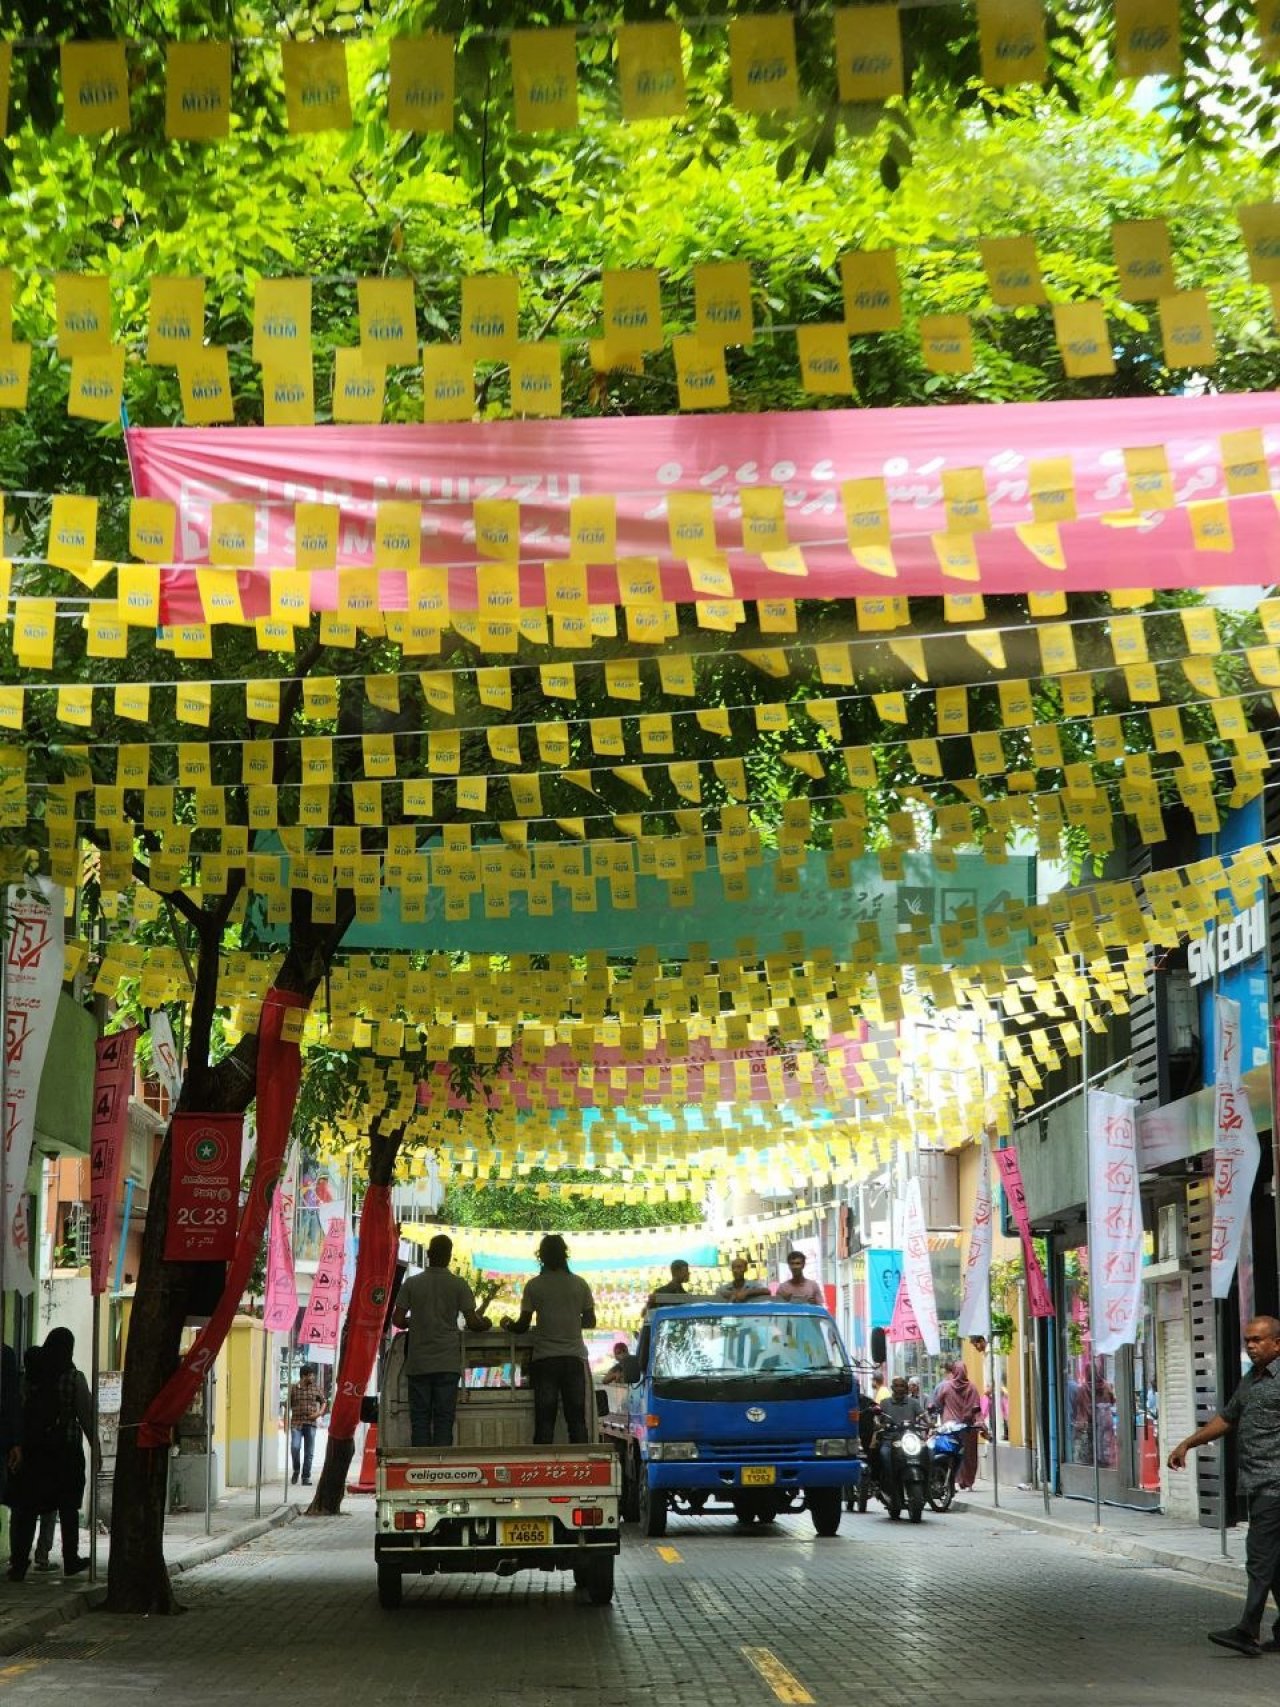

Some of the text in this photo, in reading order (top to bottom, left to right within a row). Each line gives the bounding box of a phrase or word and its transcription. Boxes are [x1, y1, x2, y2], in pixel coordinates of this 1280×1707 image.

[748, 65, 787, 84] MDP
[637, 76, 675, 95] MDP
[79, 84, 118, 106] MDP
[302, 86, 340, 106] MDP
[405, 88, 444, 107] MDP
[530, 85, 569, 104] MDP
[182, 92, 221, 112] MDP
[82, 385, 113, 398] MDP
[192, 385, 222, 399] MDP
[344, 385, 375, 398] MDP
[435, 385, 465, 399] MDP
[521, 379, 551, 392] MDP
[274, 390, 304, 404] MDP
[556, 590, 581, 601] MDP
[630, 584, 655, 595] MDP
[128, 596, 152, 606] MDP
[212, 597, 234, 607] MDP
[280, 598, 304, 608] MDP
[348, 600, 373, 610] MDP
[419, 600, 442, 611] MDP
[488, 596, 512, 607] MDP
[562, 621, 586, 631] MDP
[636, 618, 659, 628] MDP
[24, 628, 47, 638] MDP
[97, 630, 120, 640] MDP
[182, 631, 206, 641] MDP
[265, 627, 287, 637] MDP
[329, 625, 350, 635] MDP
[412, 628, 435, 638] MDP
[489, 626, 513, 636] MDP
[20, 927, 32, 953] 5
[102, 1042, 118, 1063] 4
[98, 1094, 110, 1116] 4
[1222, 1099, 1235, 1119] 5
[1219, 1162, 1229, 1183] 5
[410, 1469, 478, 1482] veligaa.com
[508, 1531, 545, 1542] T4655
